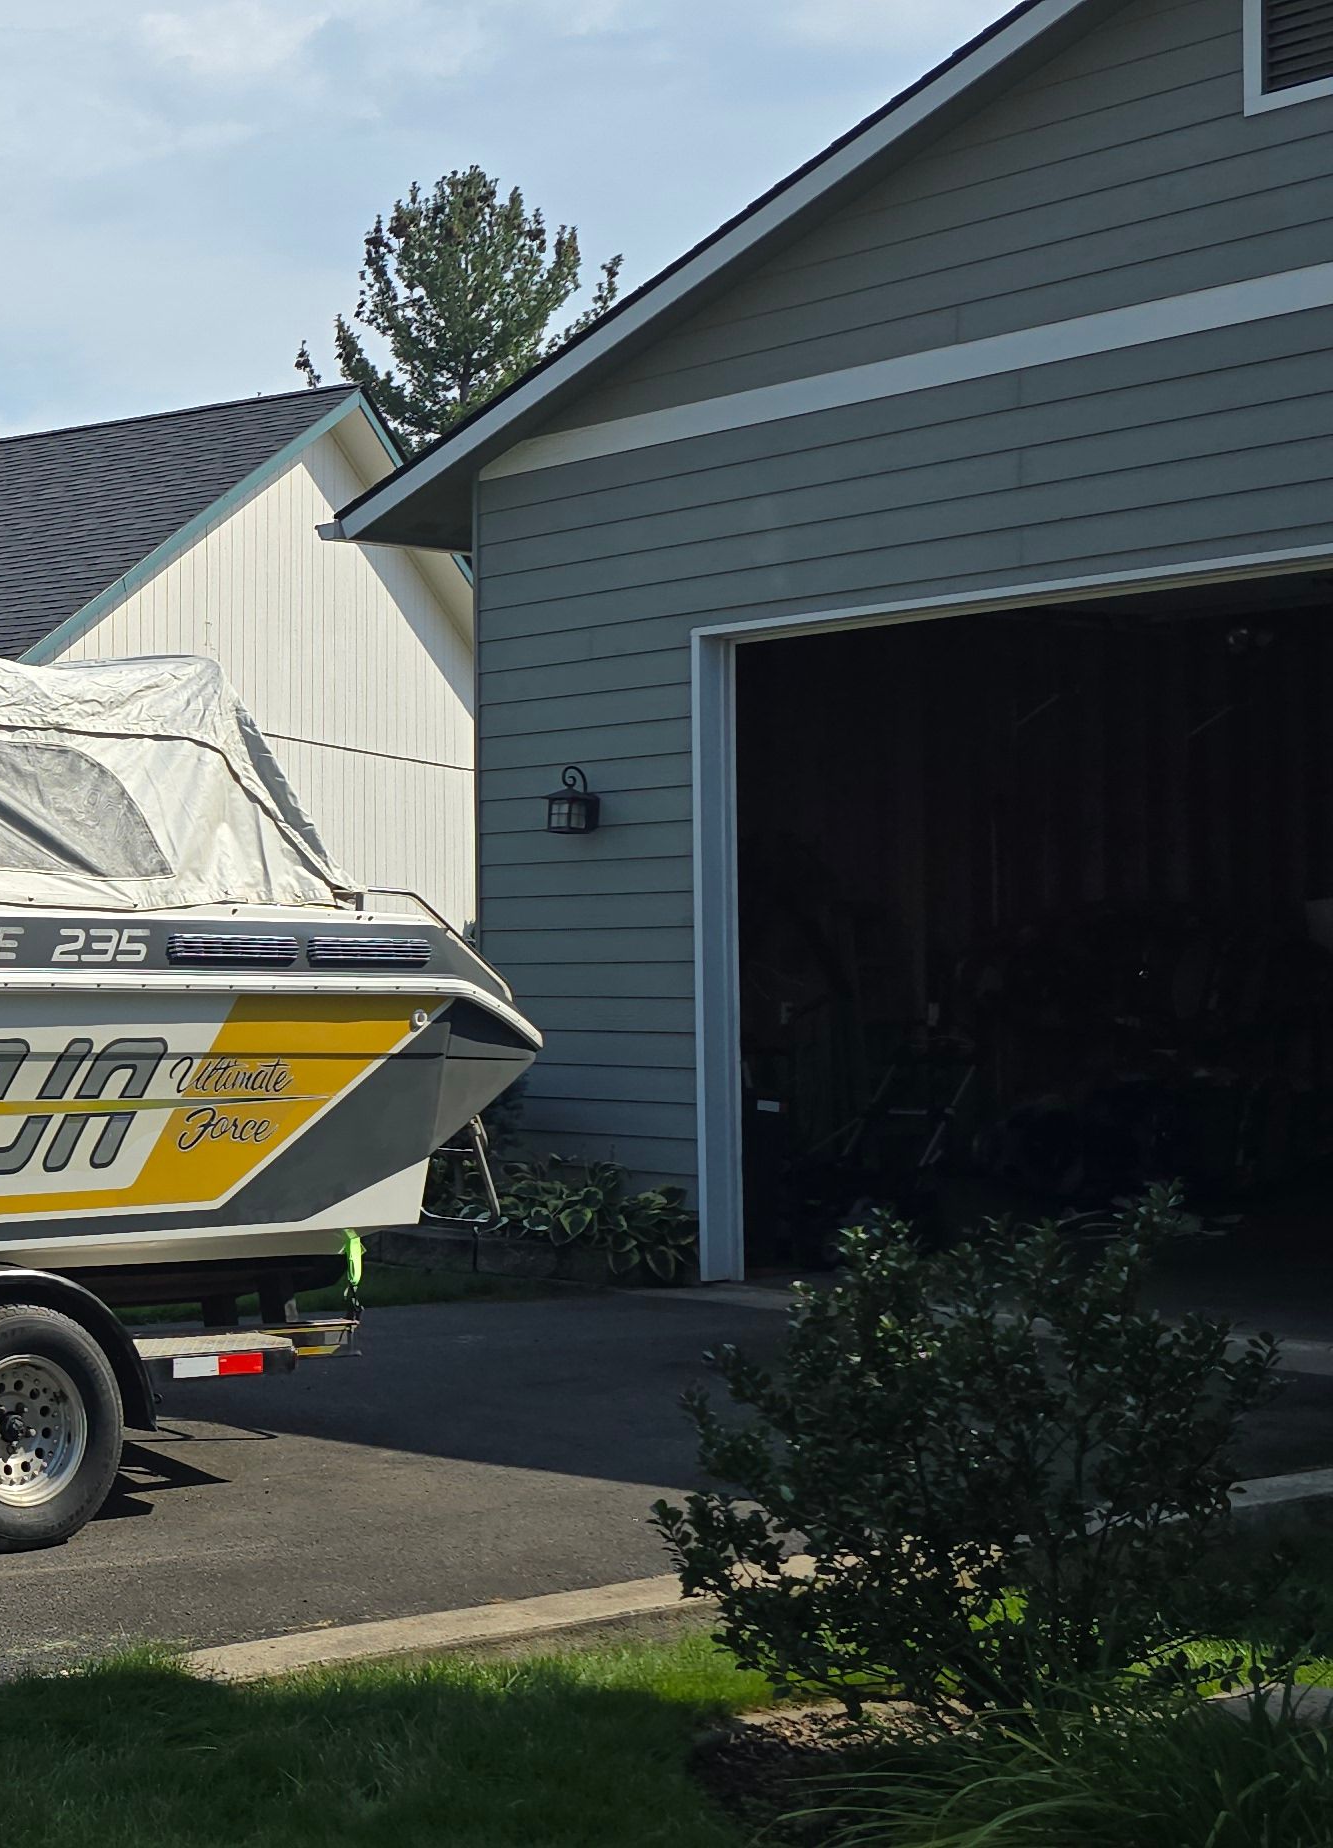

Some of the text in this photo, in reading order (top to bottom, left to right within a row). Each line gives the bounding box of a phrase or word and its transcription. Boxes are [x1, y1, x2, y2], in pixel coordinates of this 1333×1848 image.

[50, 928, 151, 962] 235
[169, 1055, 294, 1094] Ultimate
[177, 1106, 279, 1152] Force
